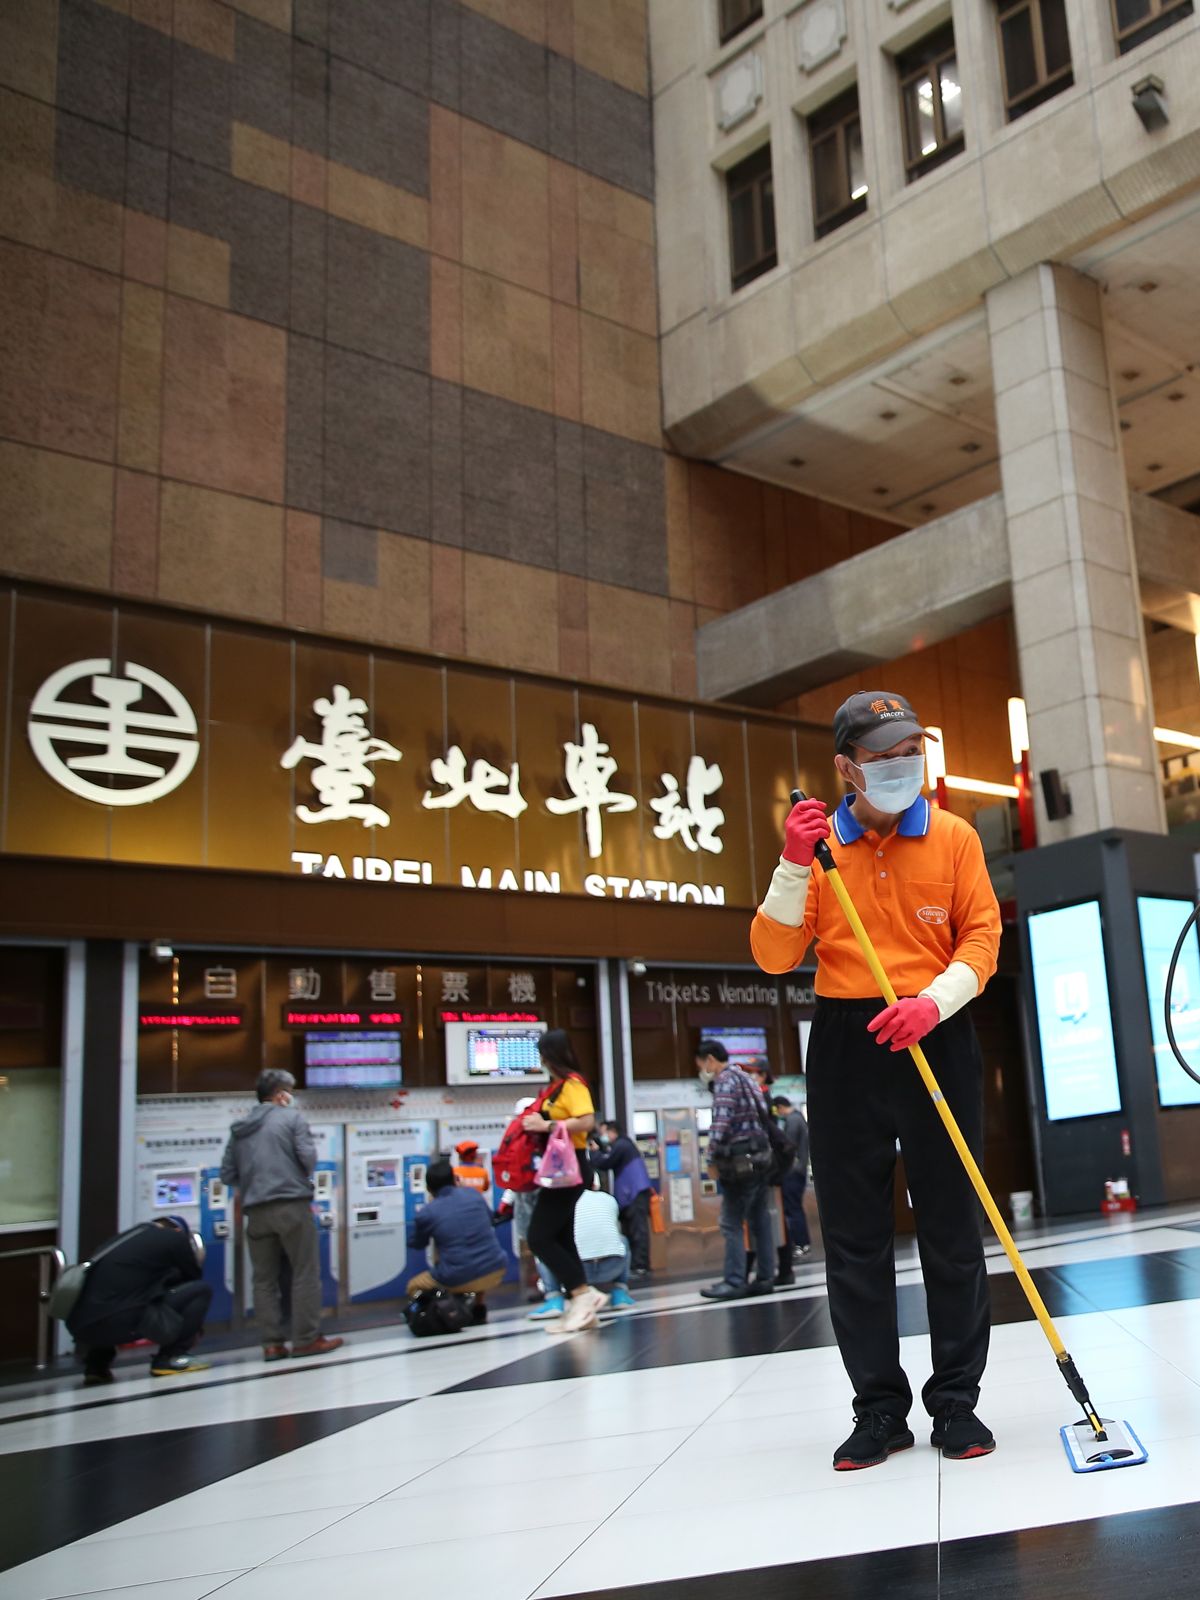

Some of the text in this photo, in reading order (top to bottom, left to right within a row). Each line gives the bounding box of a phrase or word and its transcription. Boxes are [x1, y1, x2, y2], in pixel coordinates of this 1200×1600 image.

[880, 711, 905, 719] sincere
[281, 684, 725, 858] 臺北車站
[461, 865, 561, 893] MAIN
[584, 874, 726, 906] STATION
[204, 966, 537, 1003] 自動售票機
[645, 980, 711, 1003] Tickets
[718, 983, 778, 1006] Vending
